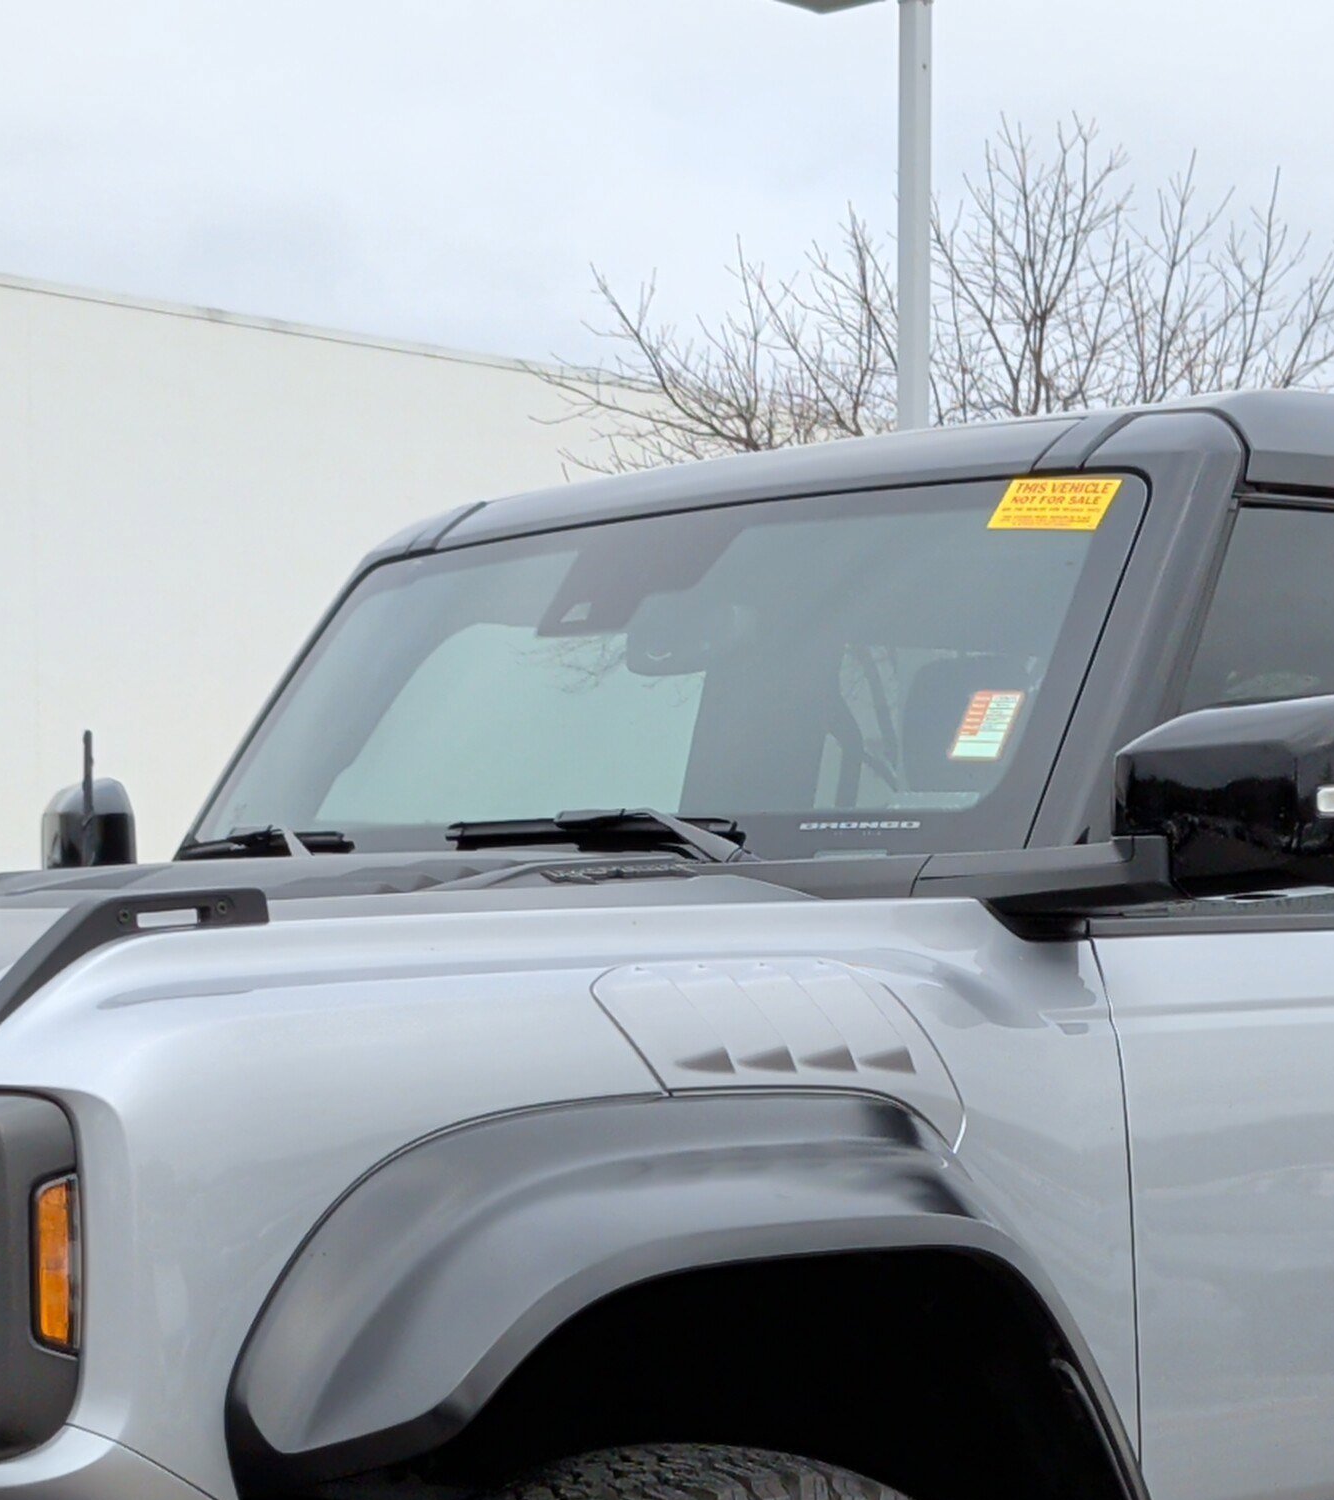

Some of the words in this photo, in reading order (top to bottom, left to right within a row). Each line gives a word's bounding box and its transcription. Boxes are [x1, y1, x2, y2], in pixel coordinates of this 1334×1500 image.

[1017, 482, 1047, 494] THIS
[1051, 481, 1112, 494] VEHICLE
[1011, 496, 1037, 504] NOT
[1039, 496, 1066, 505] FOR
[1069, 496, 1101, 505] SALE
[799, 821, 920, 830] BRONCO
